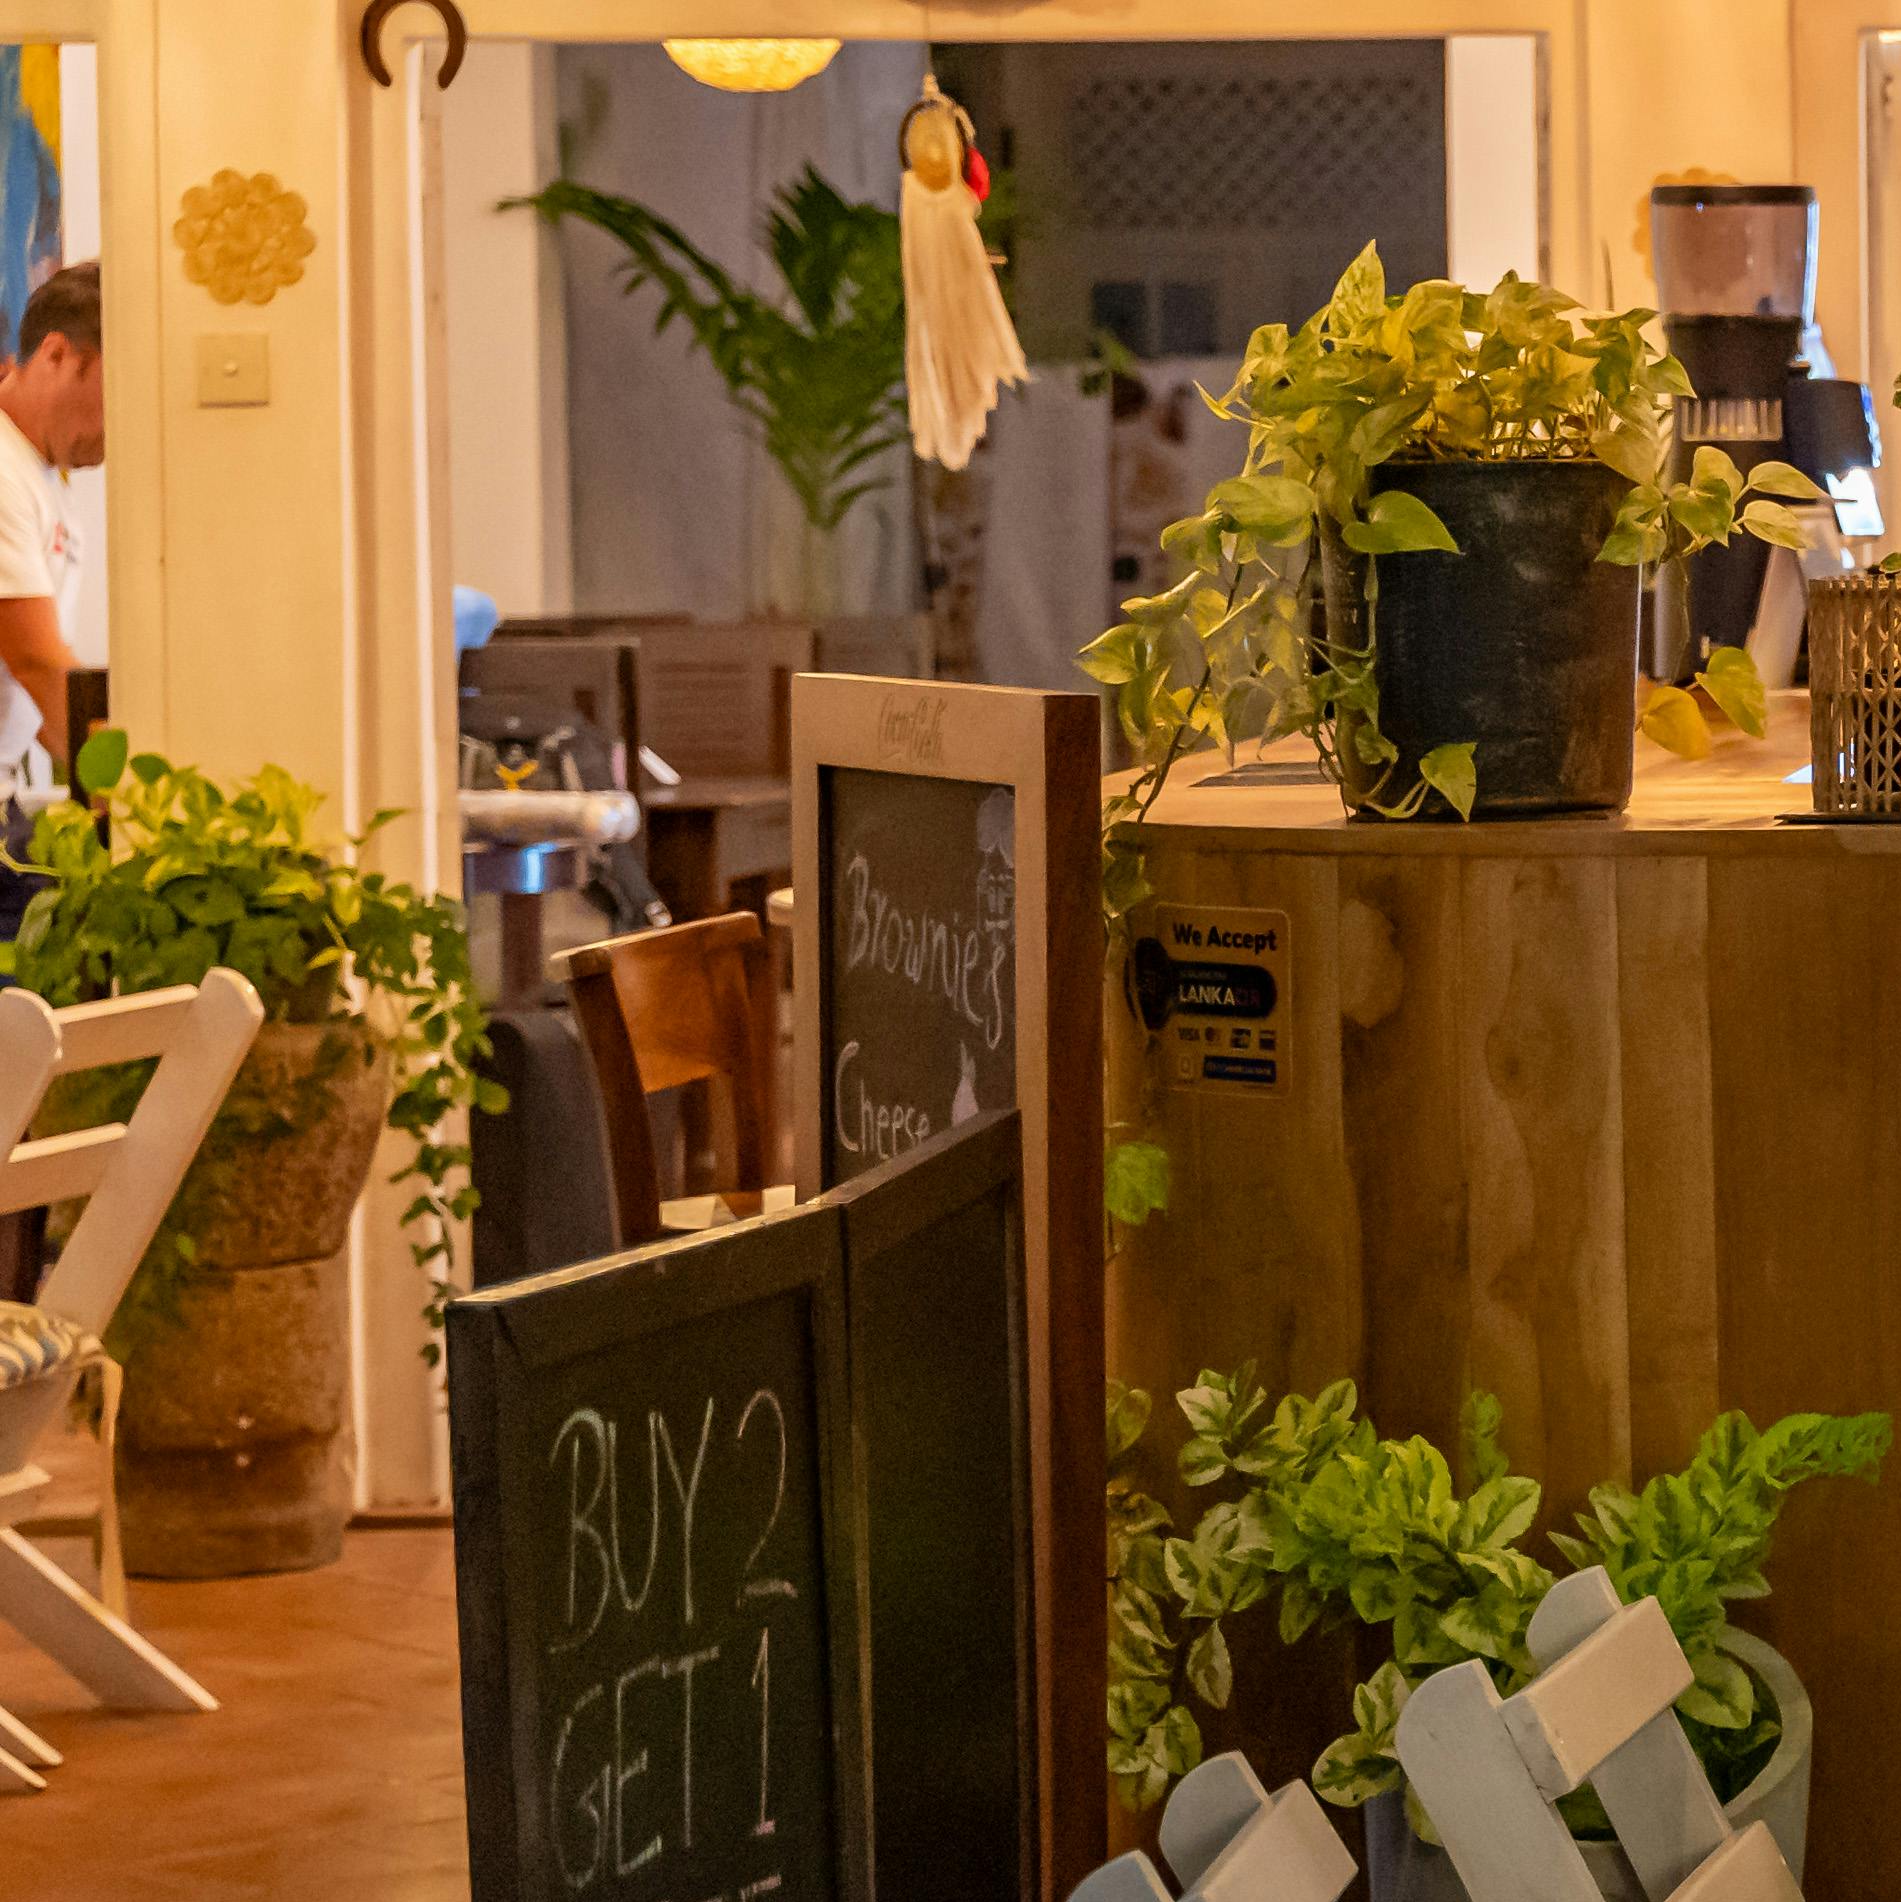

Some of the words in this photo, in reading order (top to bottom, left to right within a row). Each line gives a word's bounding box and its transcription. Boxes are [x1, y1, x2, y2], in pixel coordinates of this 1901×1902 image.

[1173, 922, 1201, 947] We
[1207, 926, 1277, 955] Accept
[548, 1397, 715, 1655] BUY
[736, 1389, 799, 1608] 2
[552, 1645, 720, 1890] GET
[752, 1626, 776, 1838] 1
